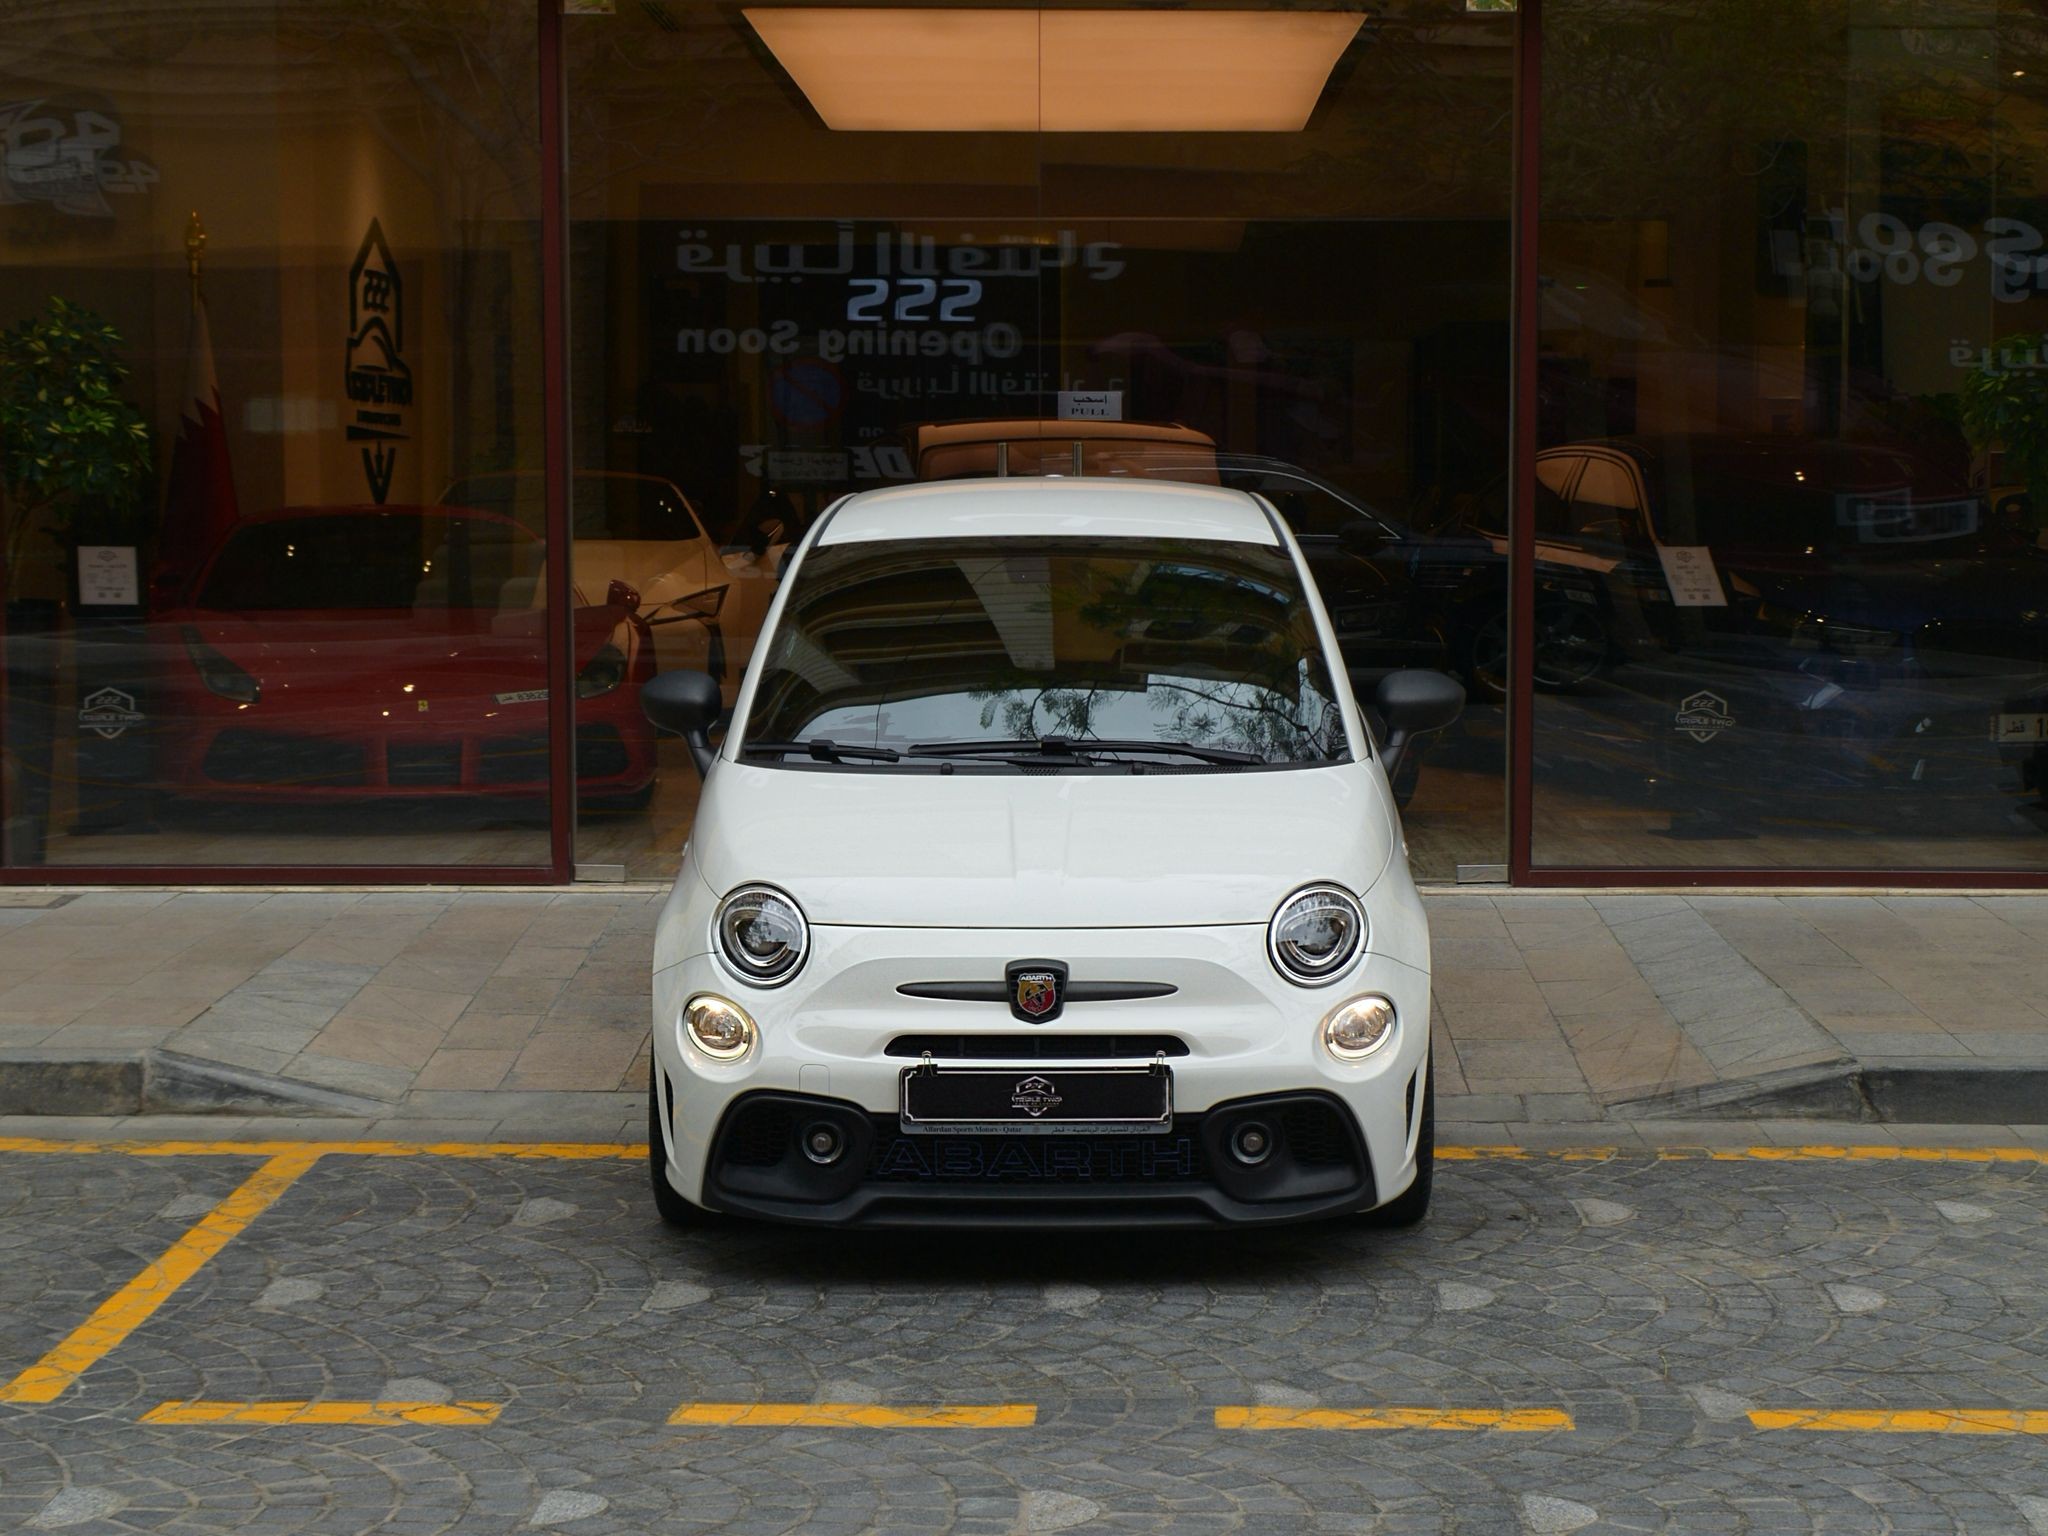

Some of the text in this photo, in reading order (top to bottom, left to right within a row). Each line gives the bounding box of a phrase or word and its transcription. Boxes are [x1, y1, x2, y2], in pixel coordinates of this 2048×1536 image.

[846, 277, 983, 323] 222
[95, 695, 121, 704] 222
[1692, 699, 1716, 708] 222
[953, 1125, 974, 1135] Sports
[975, 1125, 998, 1133] Motors
[1003, 1125, 1022, 1134] Qatar
[878, 1138, 1192, 1177] ABARTH
